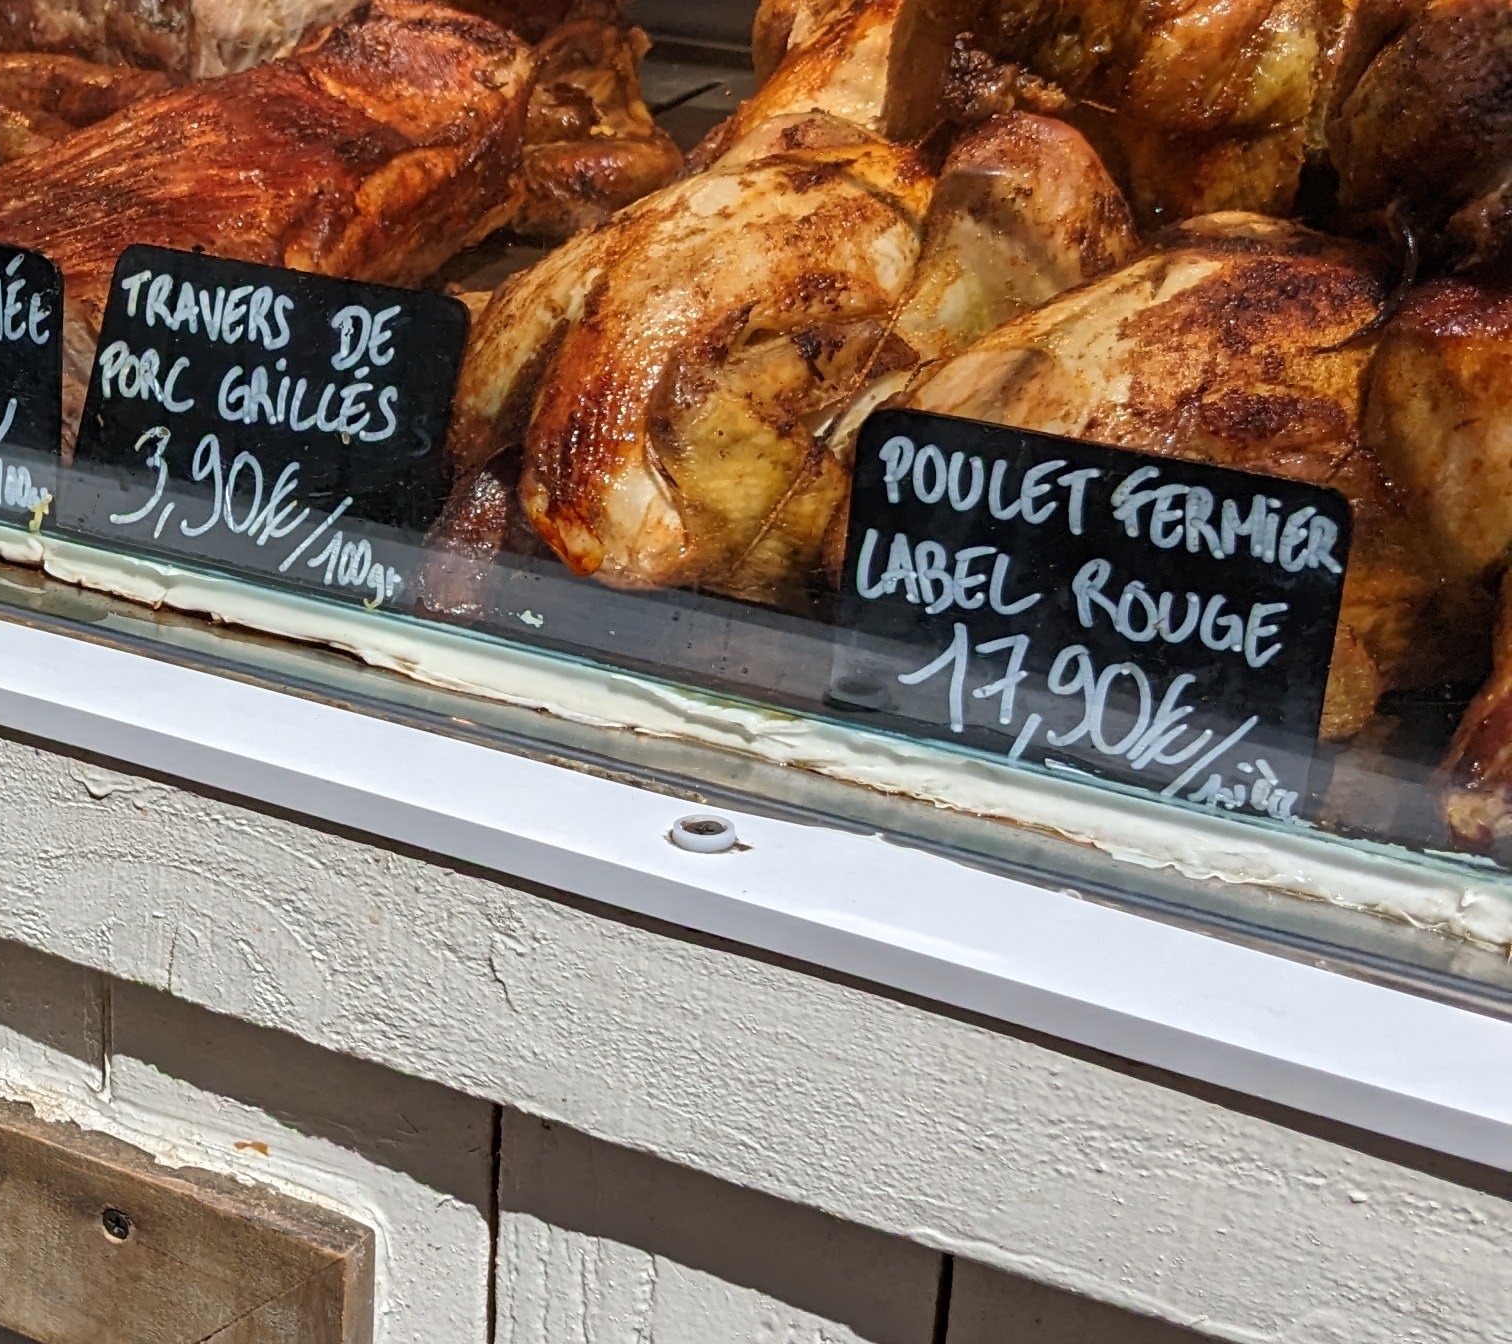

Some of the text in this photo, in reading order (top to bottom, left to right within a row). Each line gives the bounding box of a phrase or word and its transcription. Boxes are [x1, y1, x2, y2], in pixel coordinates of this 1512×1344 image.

[120, 269, 402, 372] TRAVERS DE
[99, 339, 401, 443] PORC GRILLÉS
[879, 435, 1343, 575] POULET FERMIER
[856, 528, 1289, 669] LABEL ROUGE
